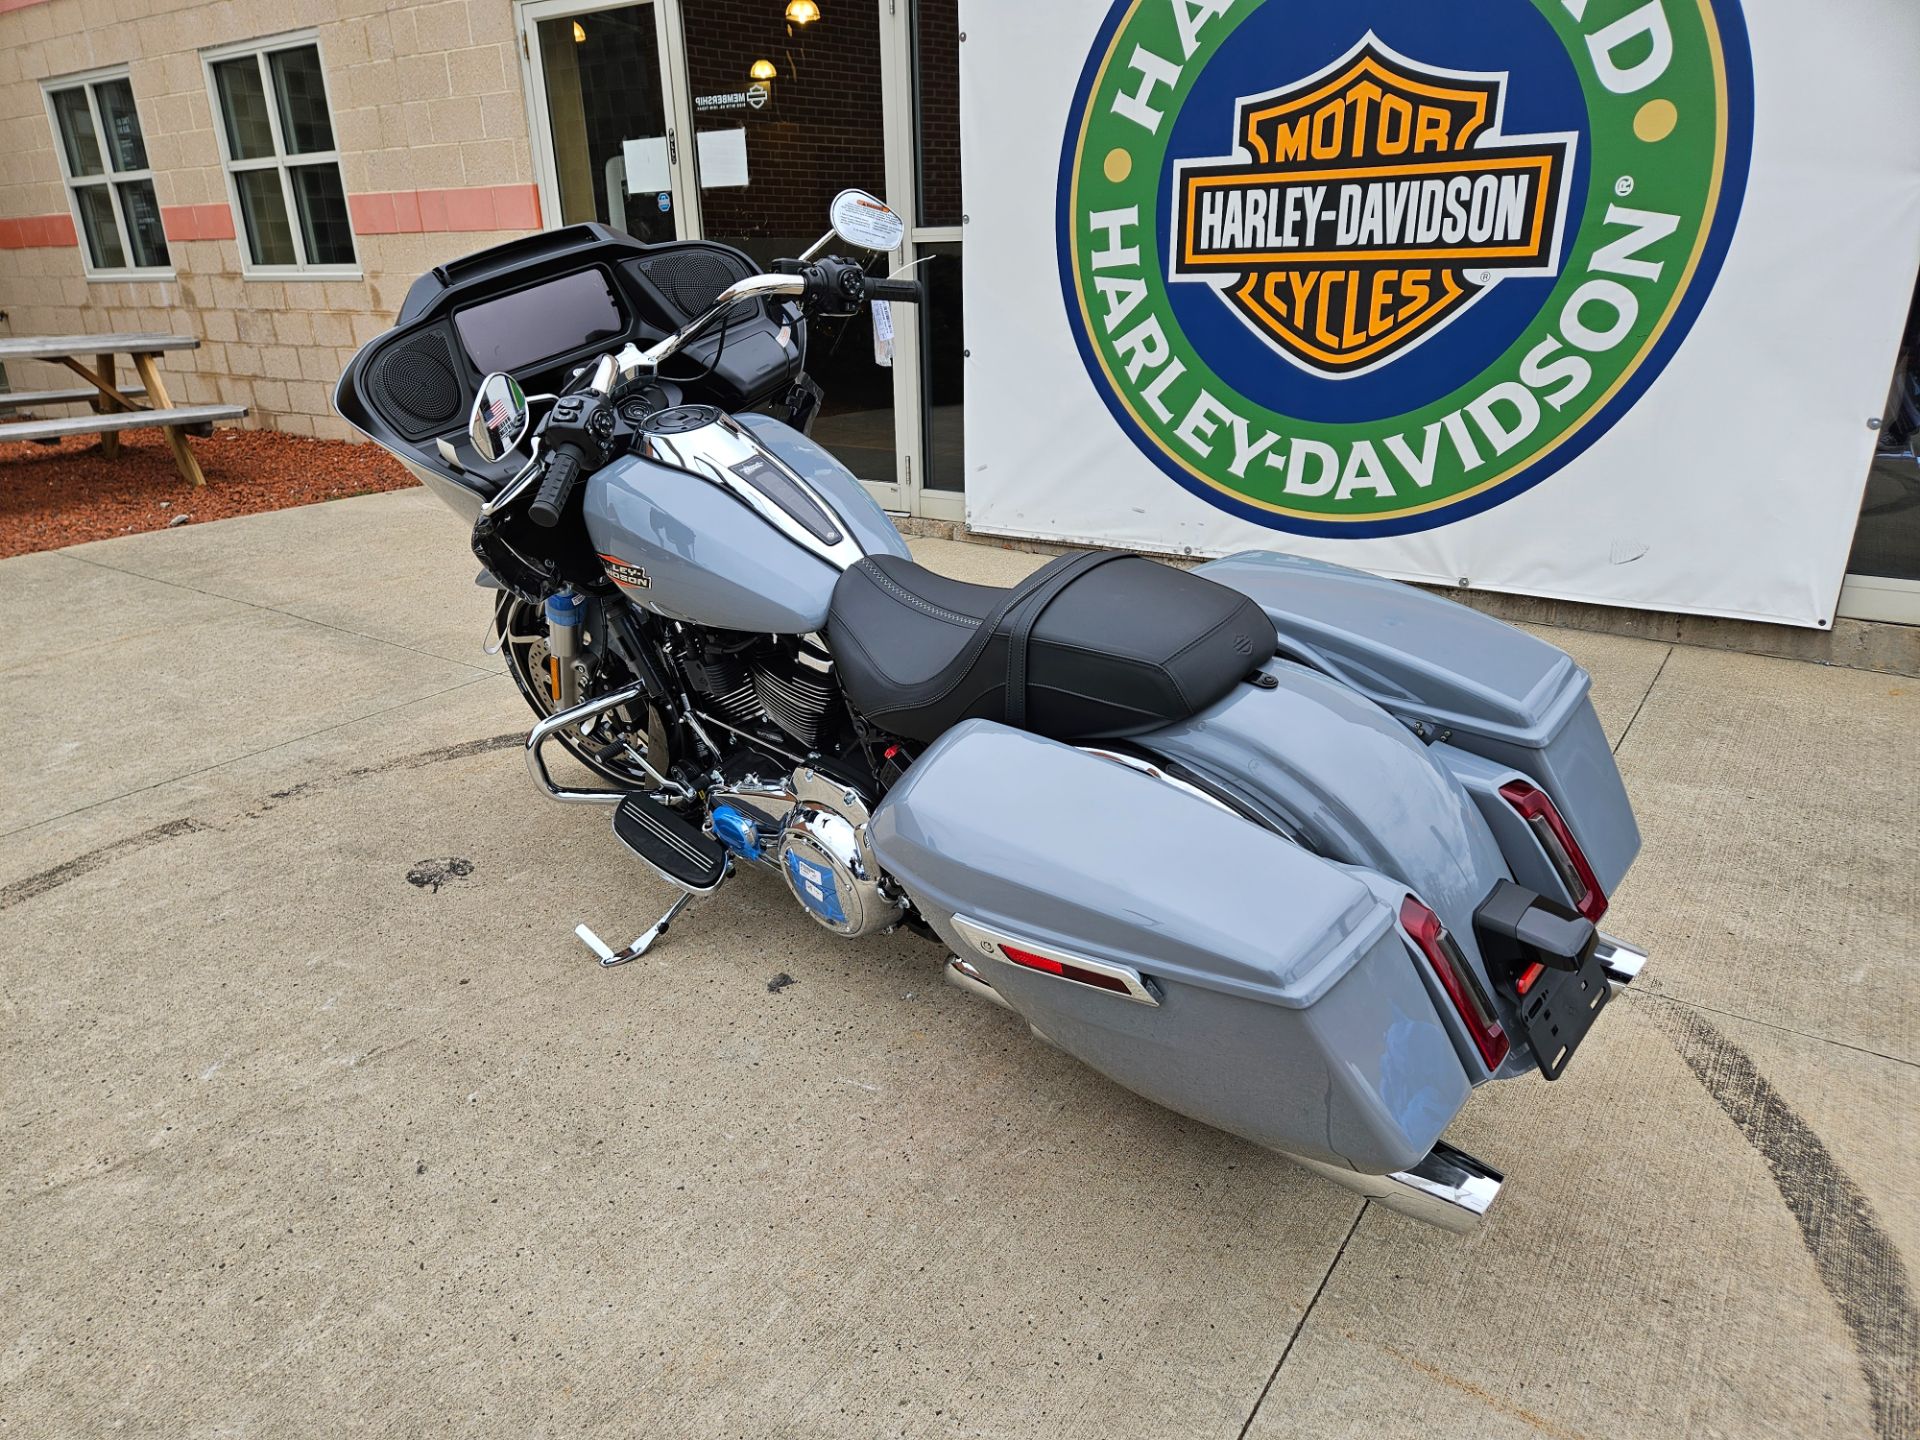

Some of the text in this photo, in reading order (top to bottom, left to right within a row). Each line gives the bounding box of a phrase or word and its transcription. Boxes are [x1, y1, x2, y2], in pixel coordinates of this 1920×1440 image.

[1275, 80, 1451, 163] MOTOR
[1199, 174, 1530, 250] HARLEY-DAVIDSON
[1263, 269, 1432, 350] CYCLES
